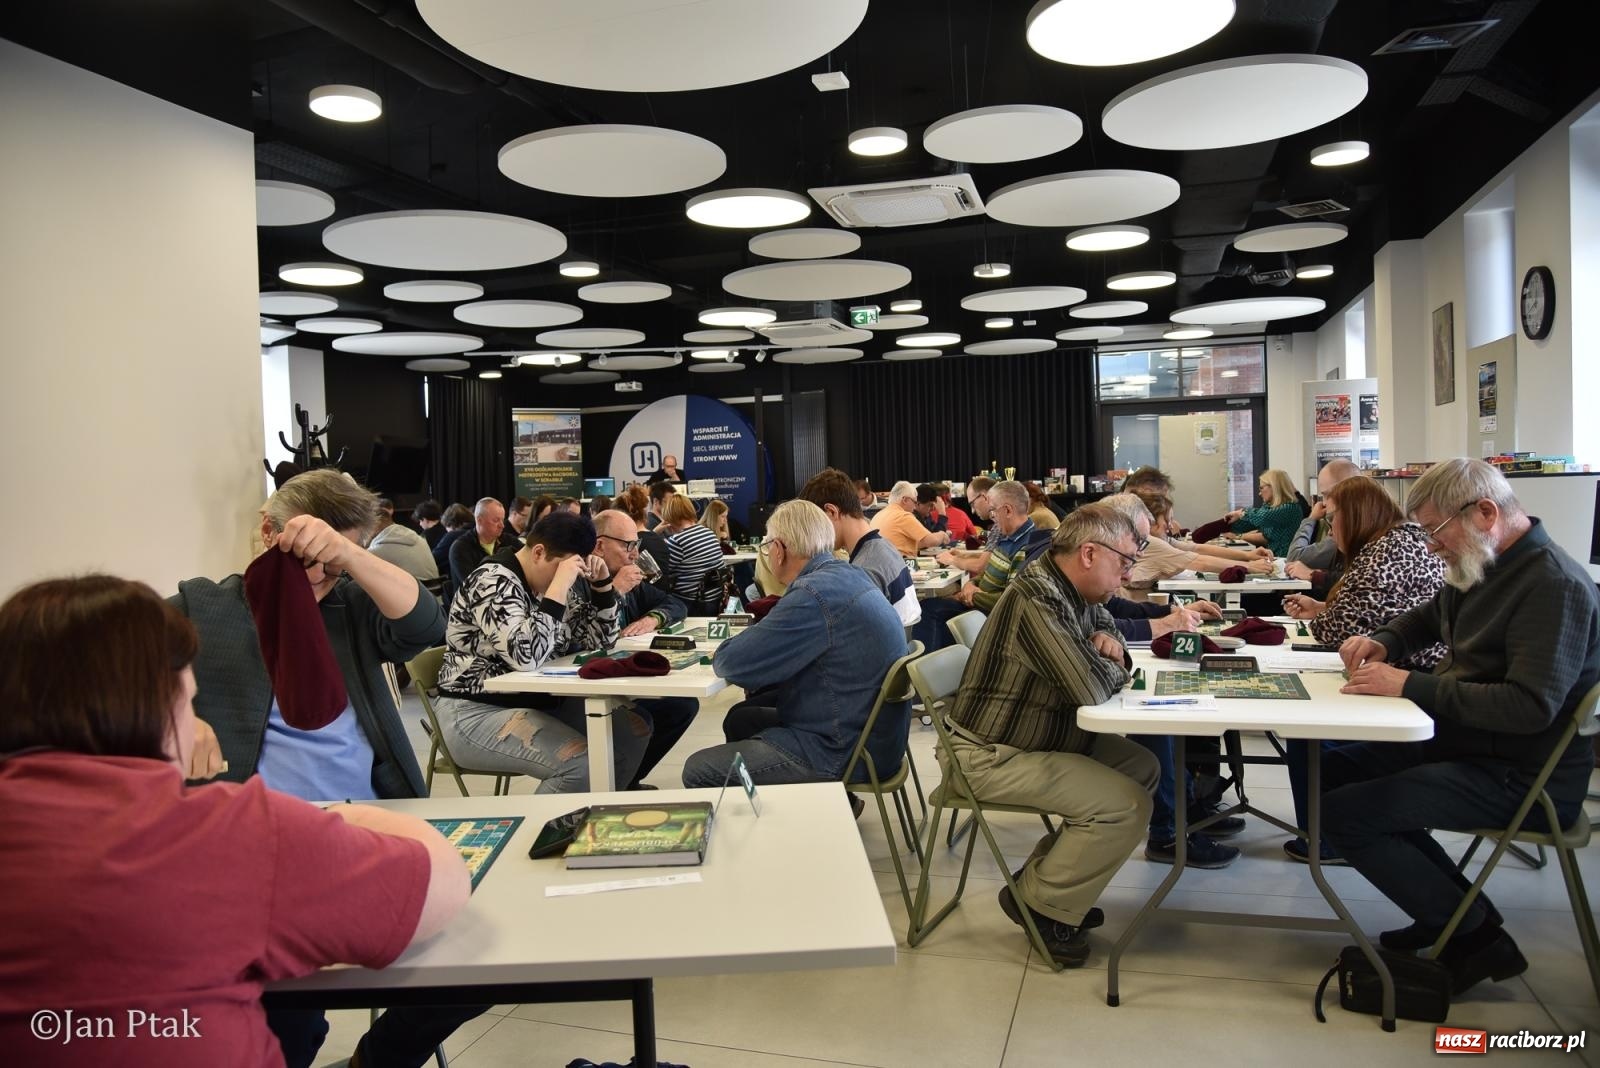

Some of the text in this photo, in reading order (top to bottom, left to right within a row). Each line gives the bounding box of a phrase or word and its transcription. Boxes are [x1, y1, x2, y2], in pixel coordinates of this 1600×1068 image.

[692, 426, 722, 434] WSPARCIE
[692, 432, 742, 441] ADMINISTRACJA
[709, 623, 726, 637] 27
[1175, 637, 1195, 654] 24
